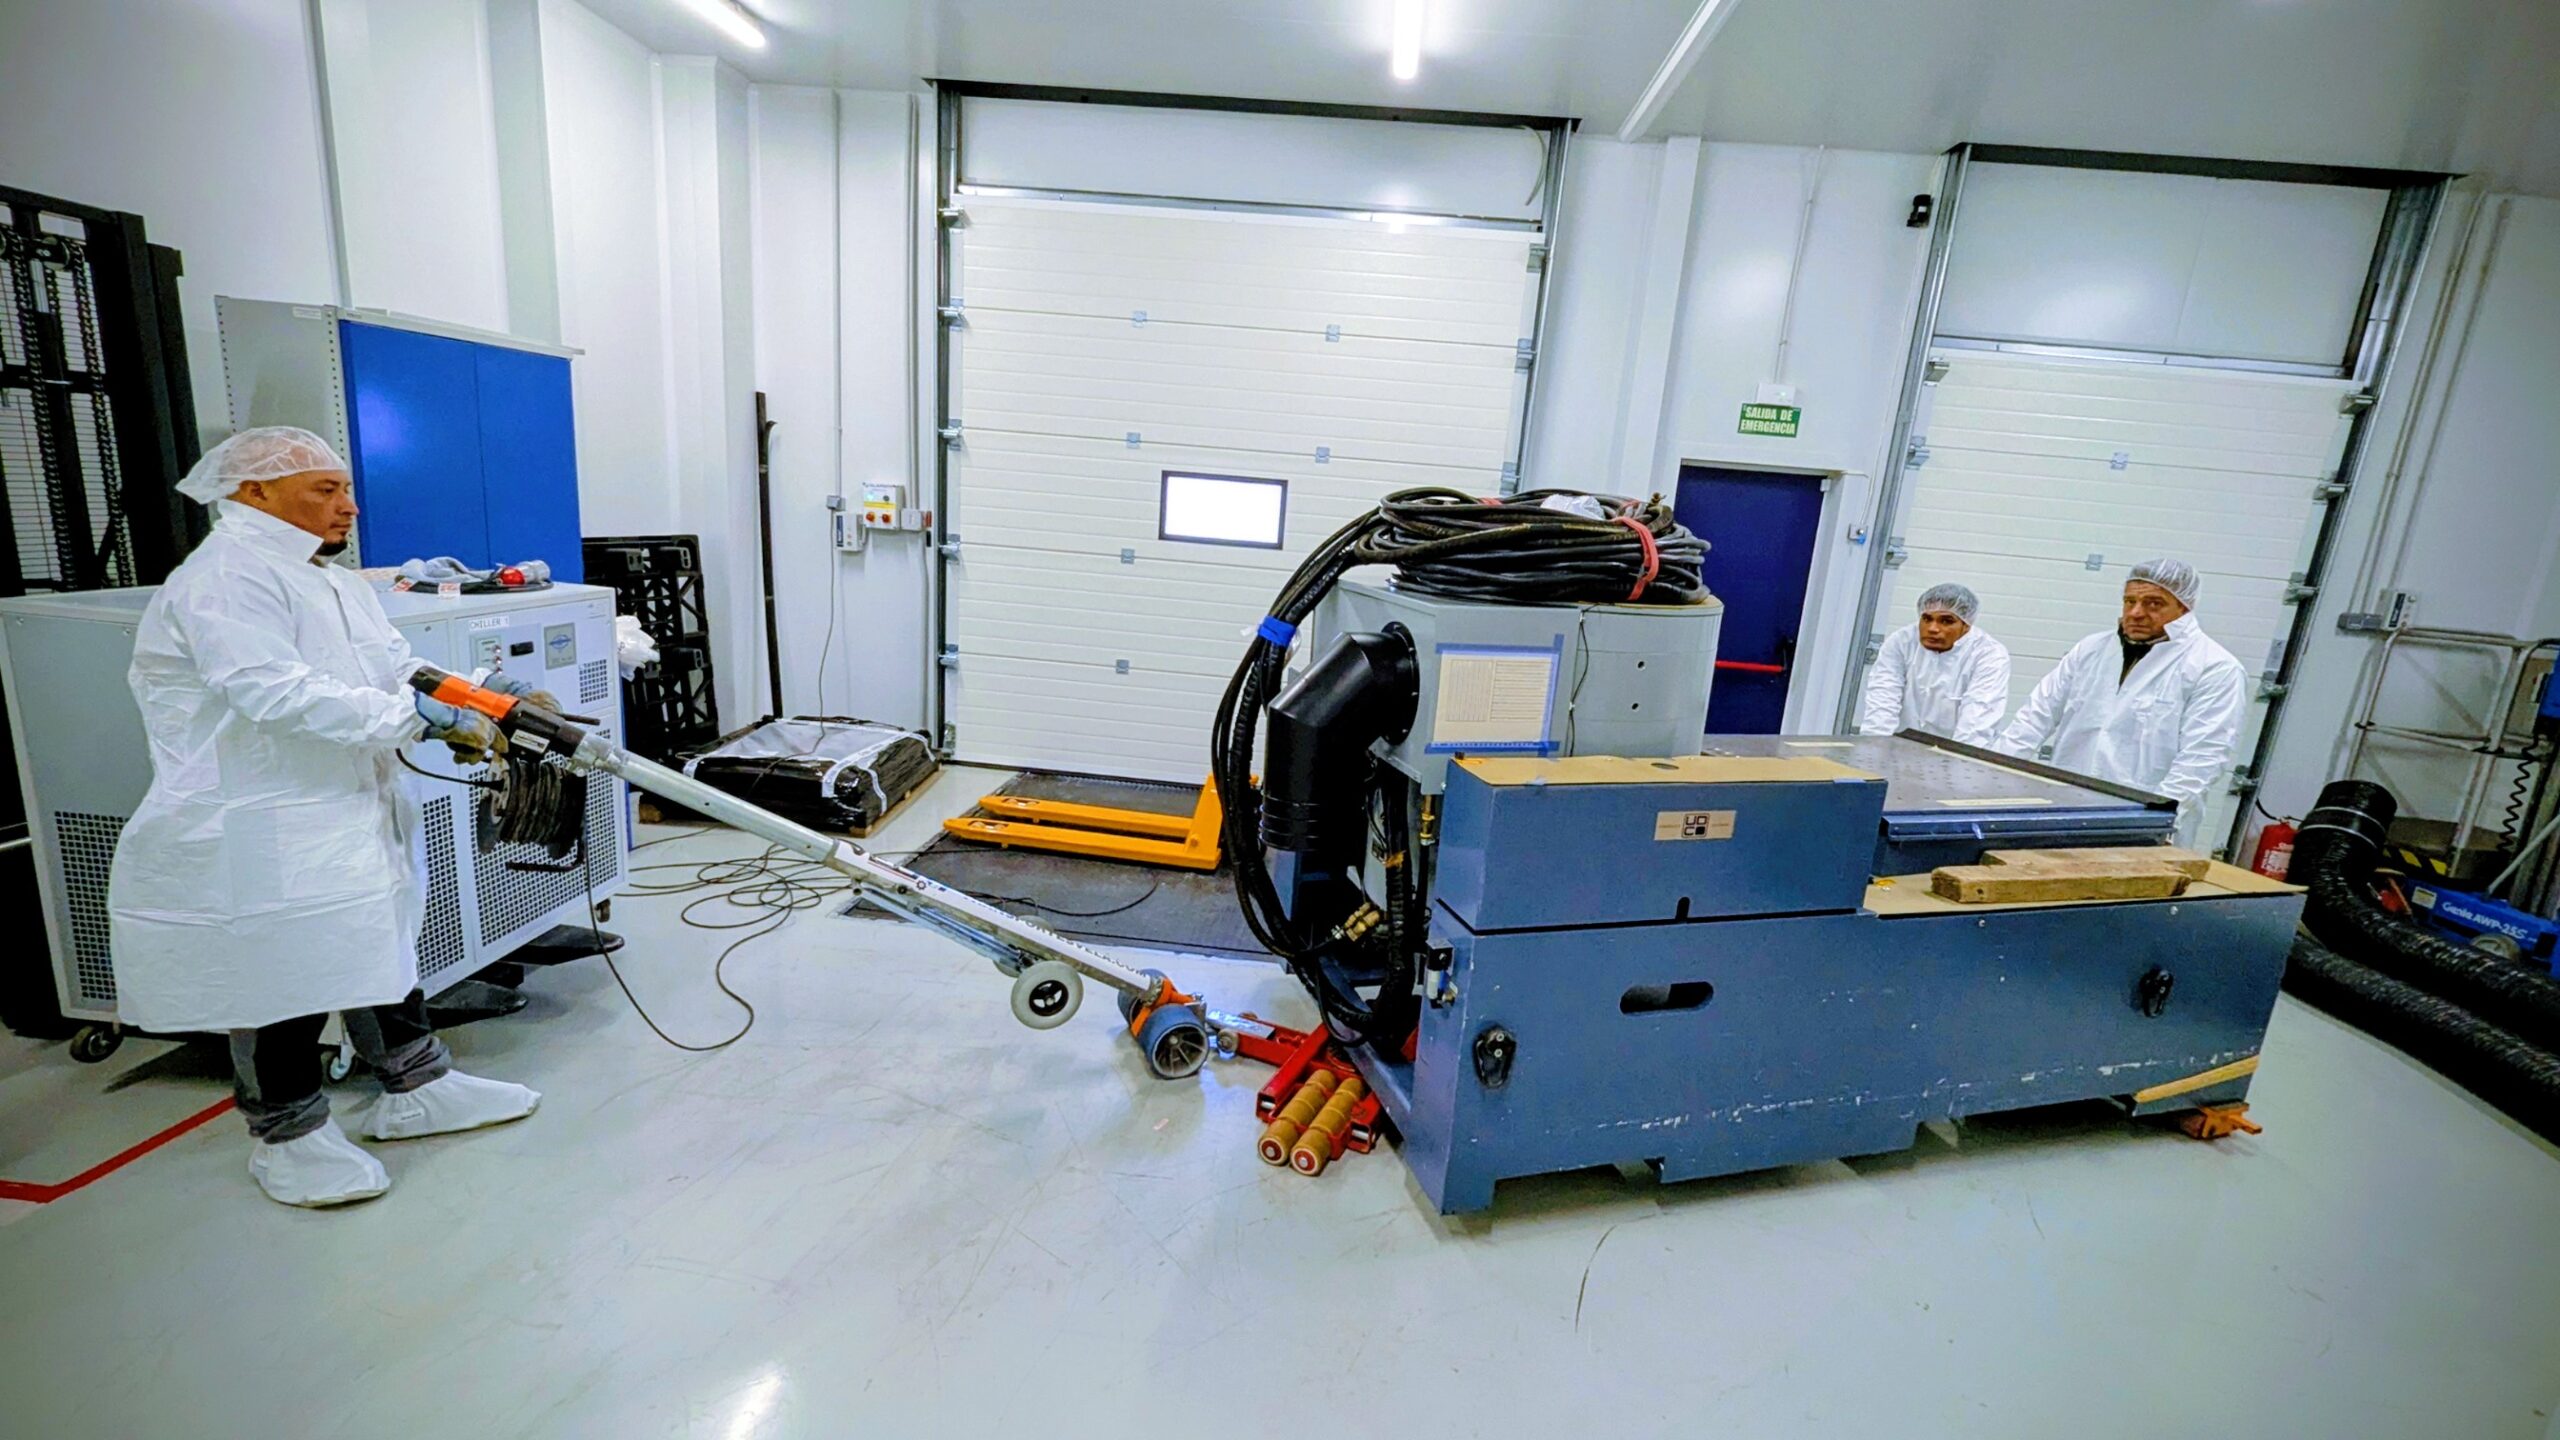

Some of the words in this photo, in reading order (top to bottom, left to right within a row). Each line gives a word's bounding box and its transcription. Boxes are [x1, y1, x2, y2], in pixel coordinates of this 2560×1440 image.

[1745, 407, 1777, 419] SALIDA
[1780, 409, 1793, 421] DE
[1740, 419, 1796, 434] EMERGENCIA
[470, 617, 501, 629] CHILLER
[2441, 901, 2473, 920] Genie
[2473, 912, 2528, 940] AWP-25S
